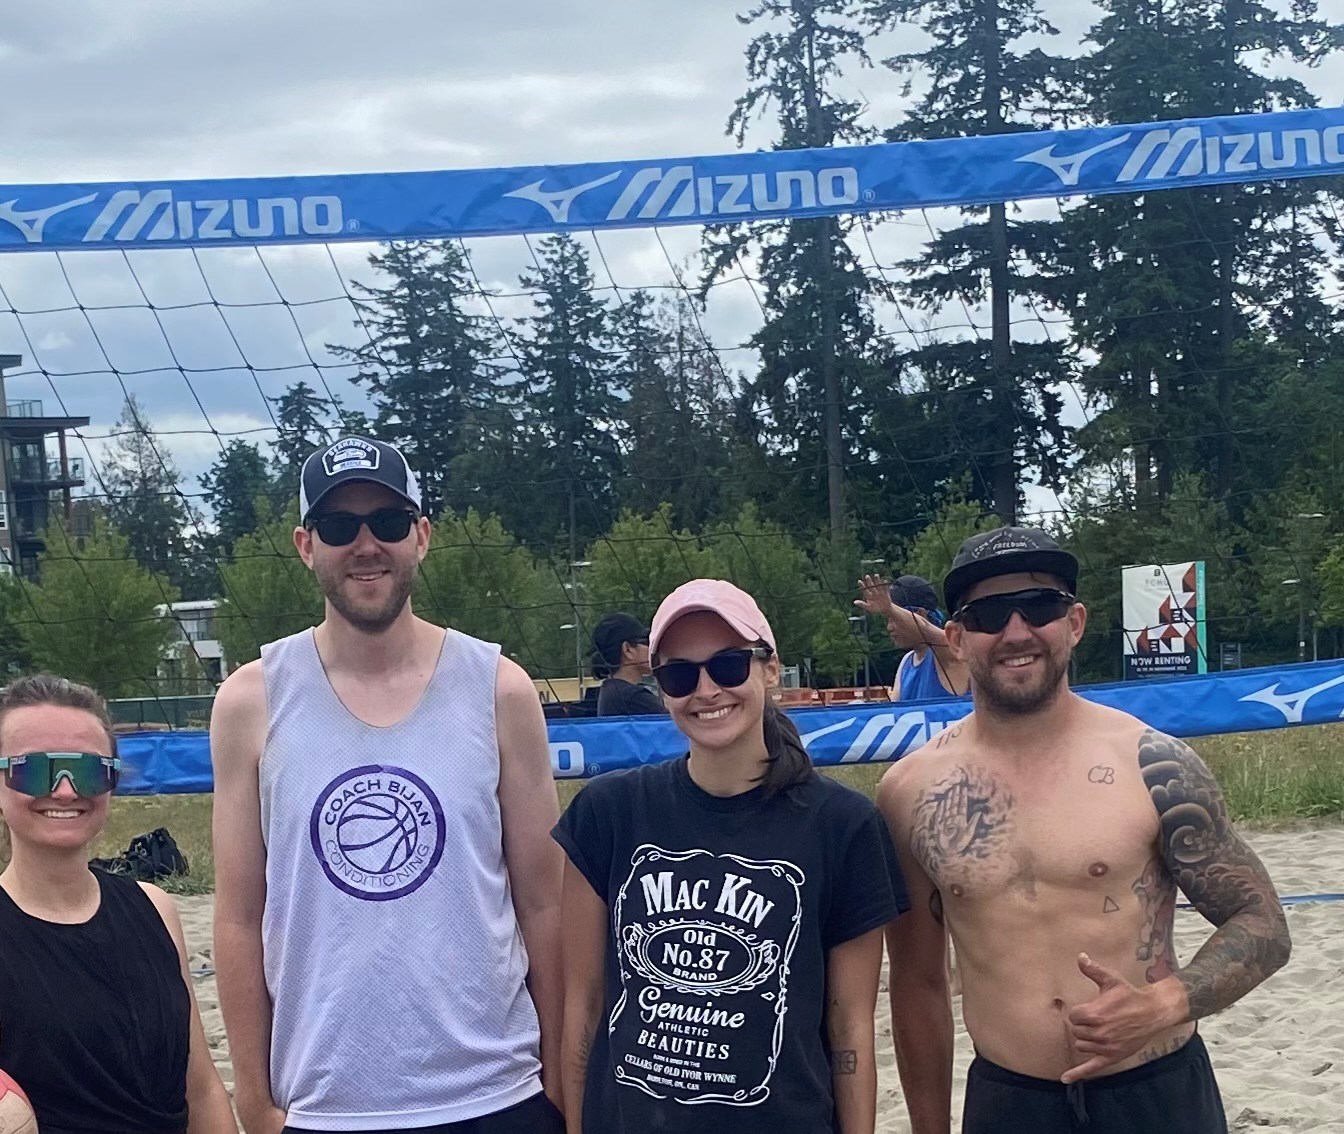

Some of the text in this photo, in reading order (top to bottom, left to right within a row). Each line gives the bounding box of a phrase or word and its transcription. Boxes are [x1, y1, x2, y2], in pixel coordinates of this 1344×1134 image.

[1130, 655, 1191, 667] NOW RENTING
[324, 779, 432, 827] COACH BIJAN
[325, 839, 430, 888] CONDITIONING
[683, 929, 717, 948] Old
[672, 967, 718, 982] BRAND
[638, 985, 746, 1029] Genuine
[657, 1021, 710, 1037] ATHLETIC
[637, 1029, 731, 1060] BEAUTIES
[624, 1053, 653, 1071] CELLARS
[653, 1063, 664, 1074] OF
[663, 1066, 681, 1078] OLD
[681, 1069, 702, 1081] IVOR
